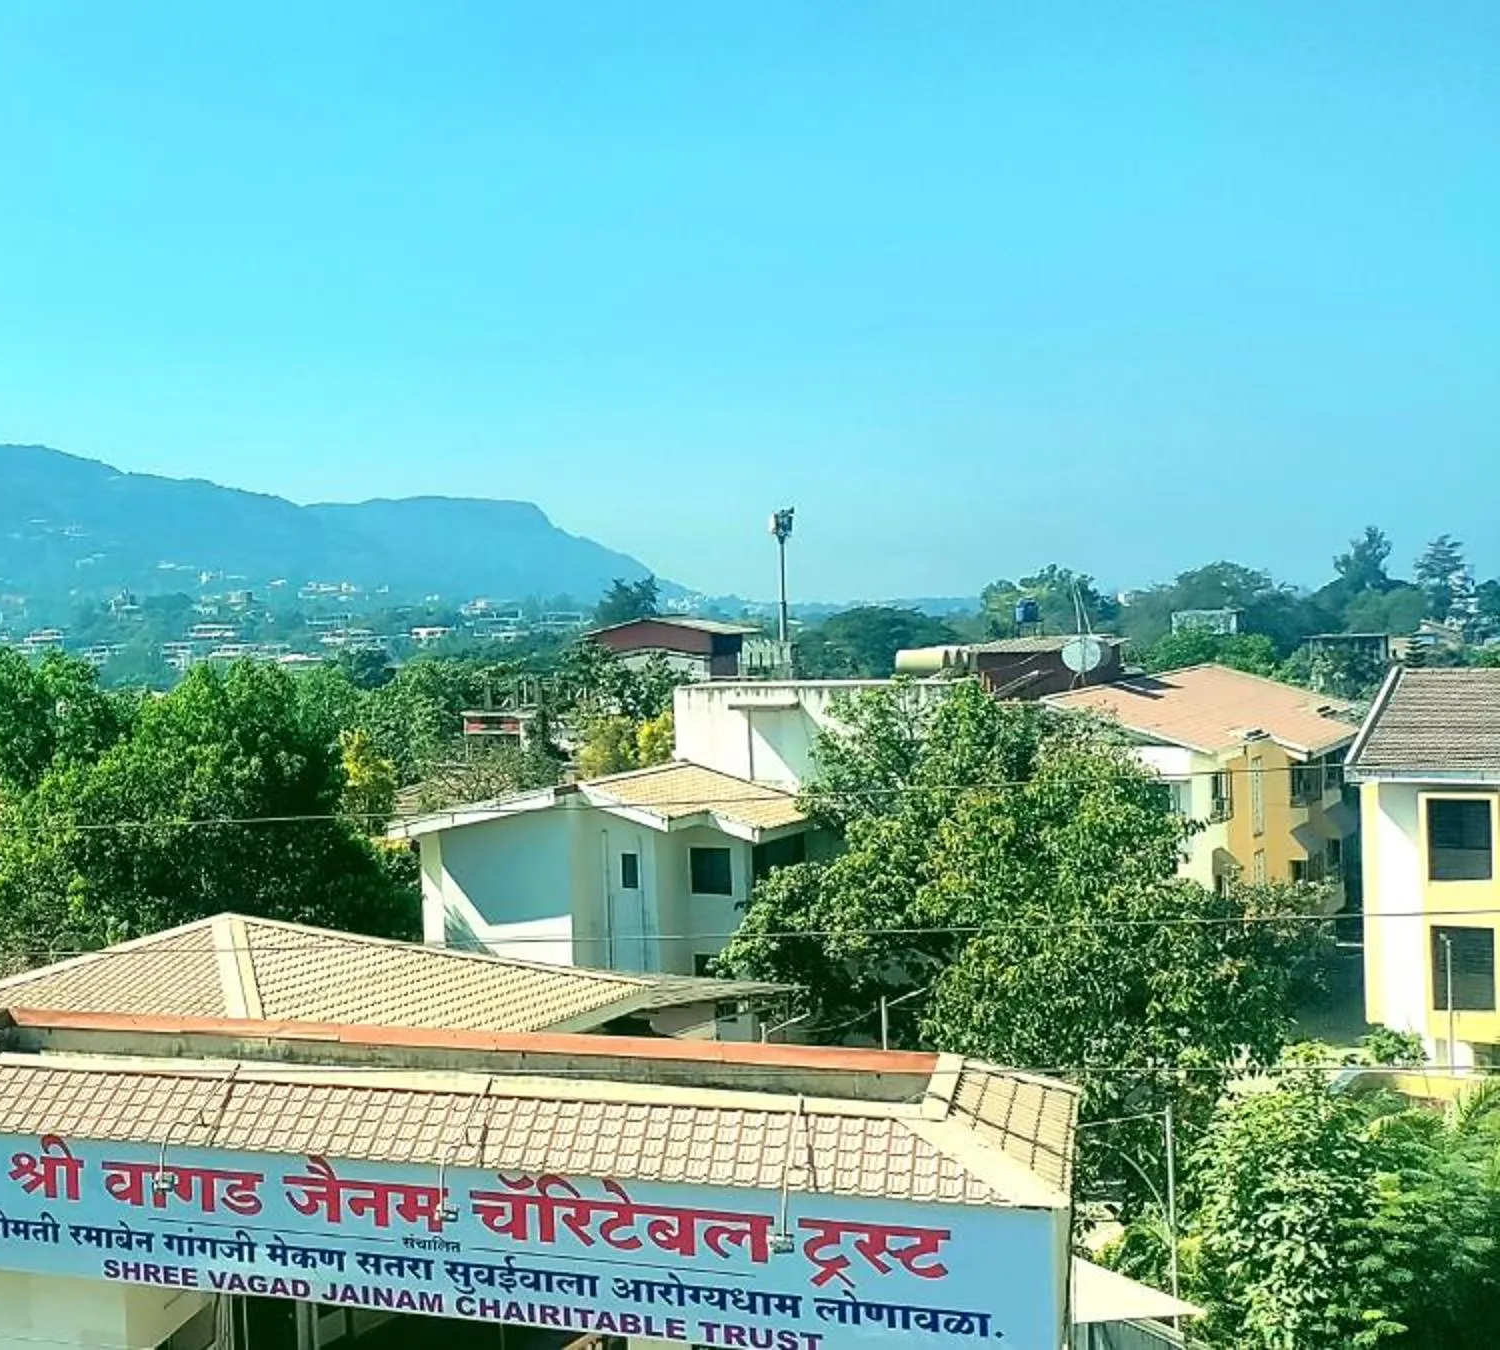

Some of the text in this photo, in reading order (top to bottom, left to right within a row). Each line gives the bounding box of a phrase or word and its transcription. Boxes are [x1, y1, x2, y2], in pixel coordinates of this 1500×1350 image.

[8, 1134, 84, 1200] श्री
[102, 1161, 264, 1215] वागड
[283, 1156, 449, 1232] जैनम
[798, 1218, 951, 1287] ट्रस्ट
[69, 1220, 154, 1252] रमाबेन
[163, 1227, 257, 1263] गांगजी
[266, 1235, 346, 1271] मेकण
[356, 1251, 434, 1280] सतरा
[444, 1256, 598, 1298] सुवईवाला
[612, 1272, 802, 1318] आरोग्यधाम
[104, 1259, 823, 1350] SHREE VAGAD JAINAM CHAIRITABLE TRUST
